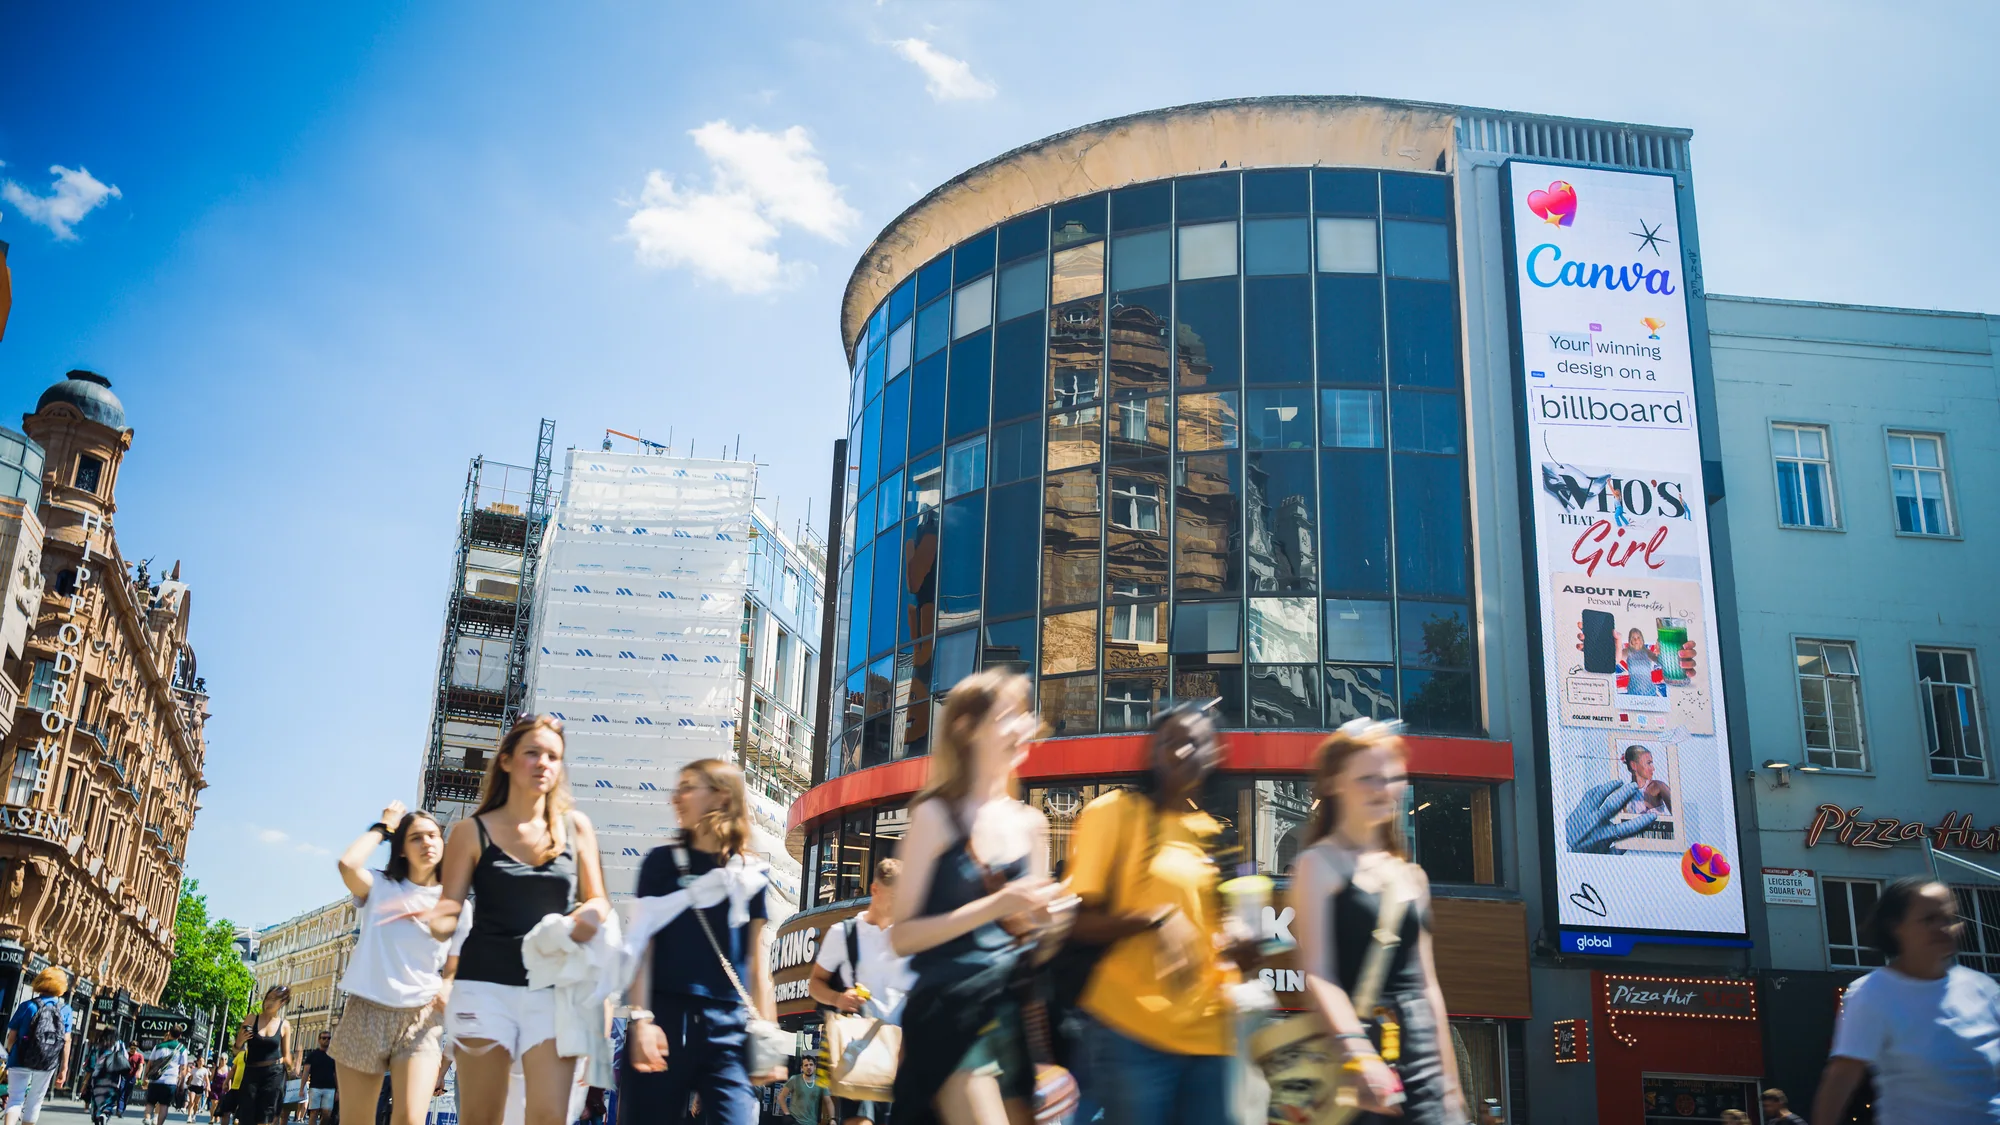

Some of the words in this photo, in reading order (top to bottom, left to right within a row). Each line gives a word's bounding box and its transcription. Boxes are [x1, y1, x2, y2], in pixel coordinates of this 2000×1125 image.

[1526, 243, 1676, 295] Canva
[1549, 335, 1590, 352] Your
[1596, 340, 1662, 361] winning
[1557, 360, 1614, 379] design
[1619, 367, 1641, 380] on
[1646, 369, 1657, 382] a
[1541, 394, 1684, 424] billboard
[1558, 513, 1595, 527] THAT
[1571, 519, 1668, 578] Girl
[1562, 584, 1615, 597] ABOUT
[1618, 588, 1651, 600] ME?
[1587, 596, 1621, 608] Personal
[32, 510, 103, 793] HIPPODROME
[1805, 803, 1927, 849] Pizza
[1768, 878, 1803, 887] LEICESTER
[1769, 886, 1796, 895] SQUARE
[1796, 888, 1812, 896] WC2
[780, 927, 817, 969] KING
[1576, 935, 1612, 950] global
[1258, 968, 1306, 992] SIN
[1613, 985, 1660, 1004] Pizza
[1662, 987, 1698, 1006] Hut
